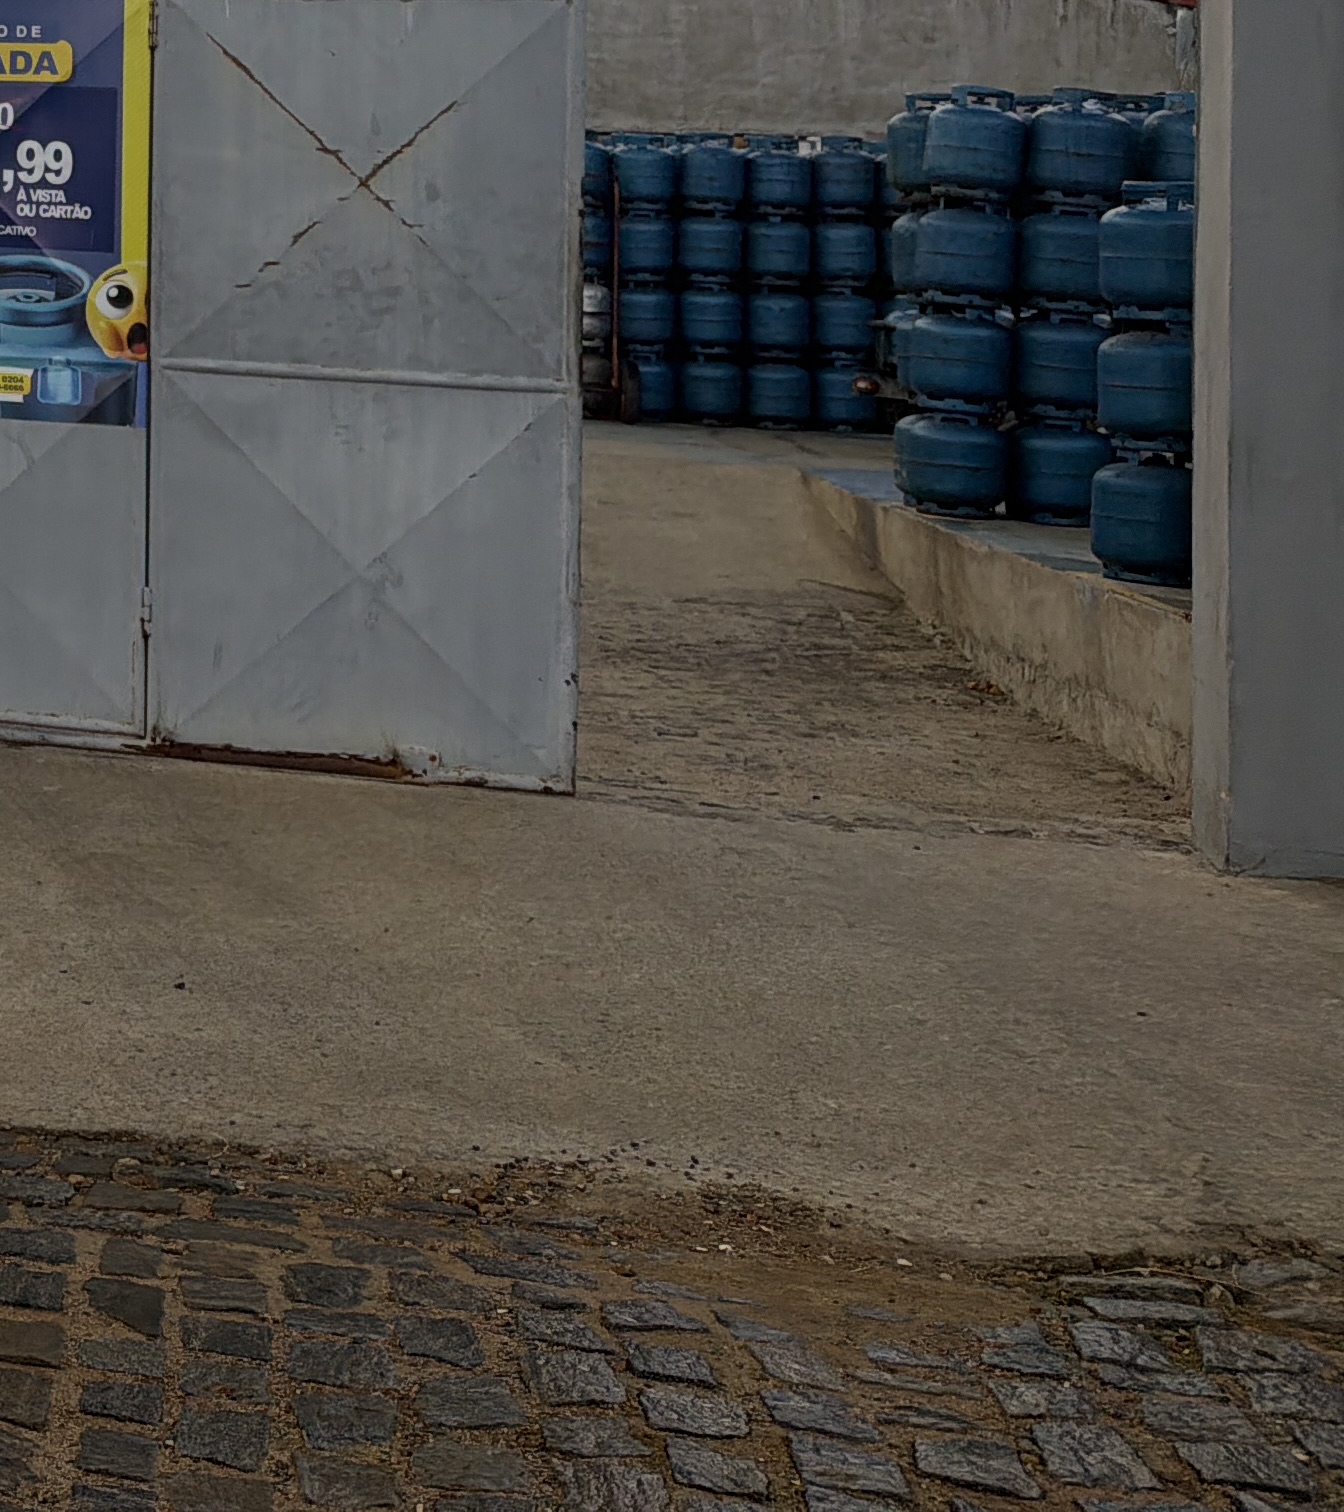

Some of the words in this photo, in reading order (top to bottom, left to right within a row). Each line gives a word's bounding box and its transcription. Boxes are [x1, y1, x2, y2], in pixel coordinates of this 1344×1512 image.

[16, 25, 42, 38] DE
[29, 190, 67, 204] VISTA
[16, 204, 37, 217] OU
[39, 204, 92, 220] CARTÃO
